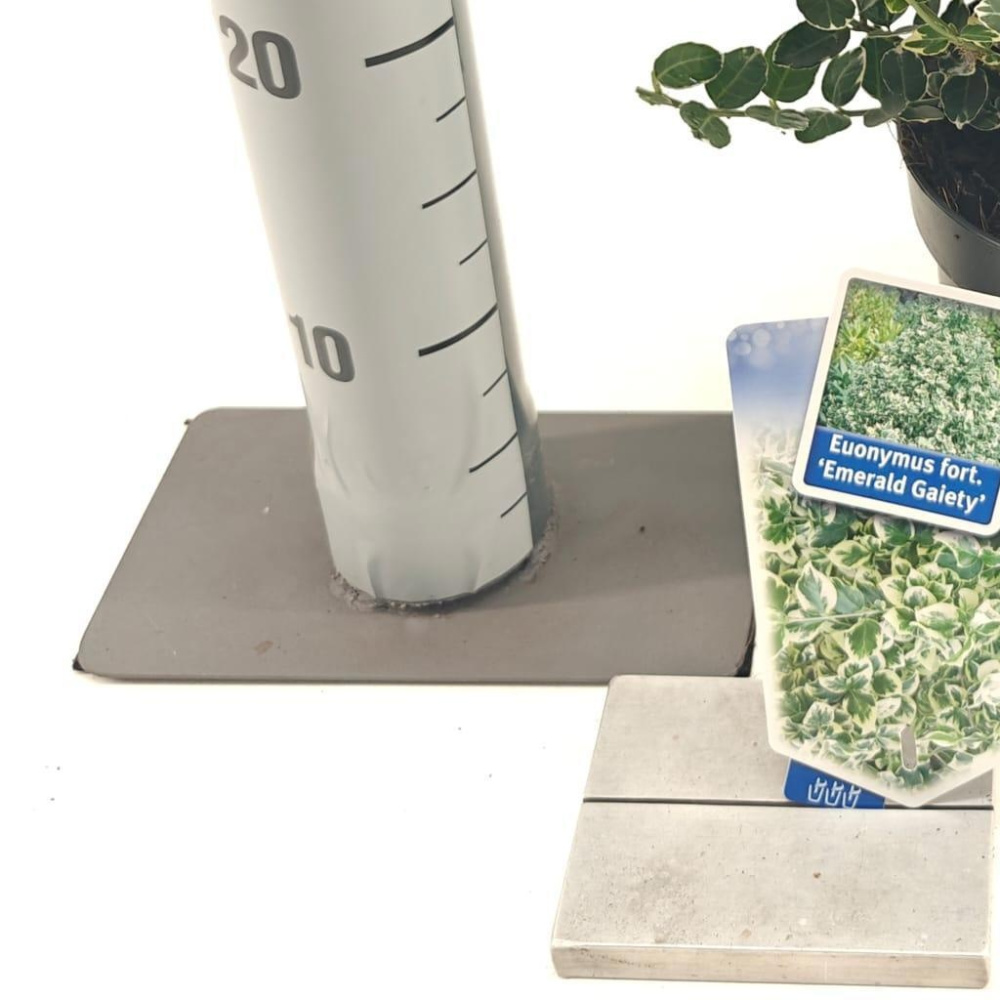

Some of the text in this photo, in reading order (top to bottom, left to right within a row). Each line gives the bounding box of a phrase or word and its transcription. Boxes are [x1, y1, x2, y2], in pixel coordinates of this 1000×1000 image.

[219, 15, 301, 99] 20
[289, 314, 355, 382] 10
[819, 459, 985, 514] ‘Emerald Gaiety’
[829, 434, 982, 484] Euonymus fort.
